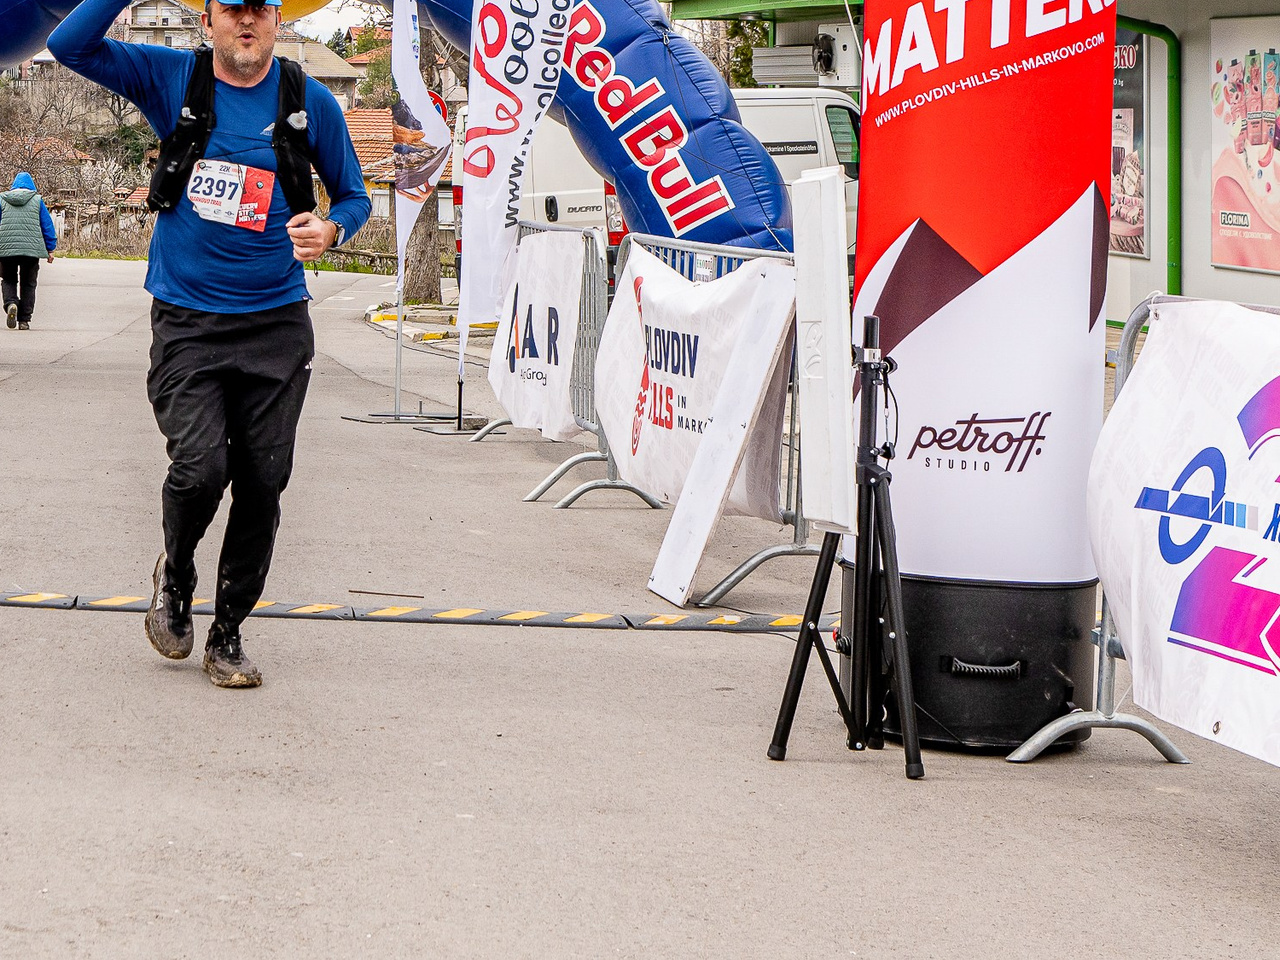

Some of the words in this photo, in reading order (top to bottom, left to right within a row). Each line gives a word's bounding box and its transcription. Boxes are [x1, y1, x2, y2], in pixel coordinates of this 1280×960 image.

[875, 32, 1105, 127] WWW.PLOVDIV-HILLS-IN-MARKOVO.COM
[563, 4, 661, 125] Red
[624, 112, 730, 233] Bull
[190, 176, 239, 200] 2397
[567, 205, 602, 213] DUCATO
[1221, 212, 1249, 227] FLORINA
[645, 325, 699, 378] PLOVDIV
[677, 395, 686, 409] IN
[925, 457, 991, 472] STUDIO
